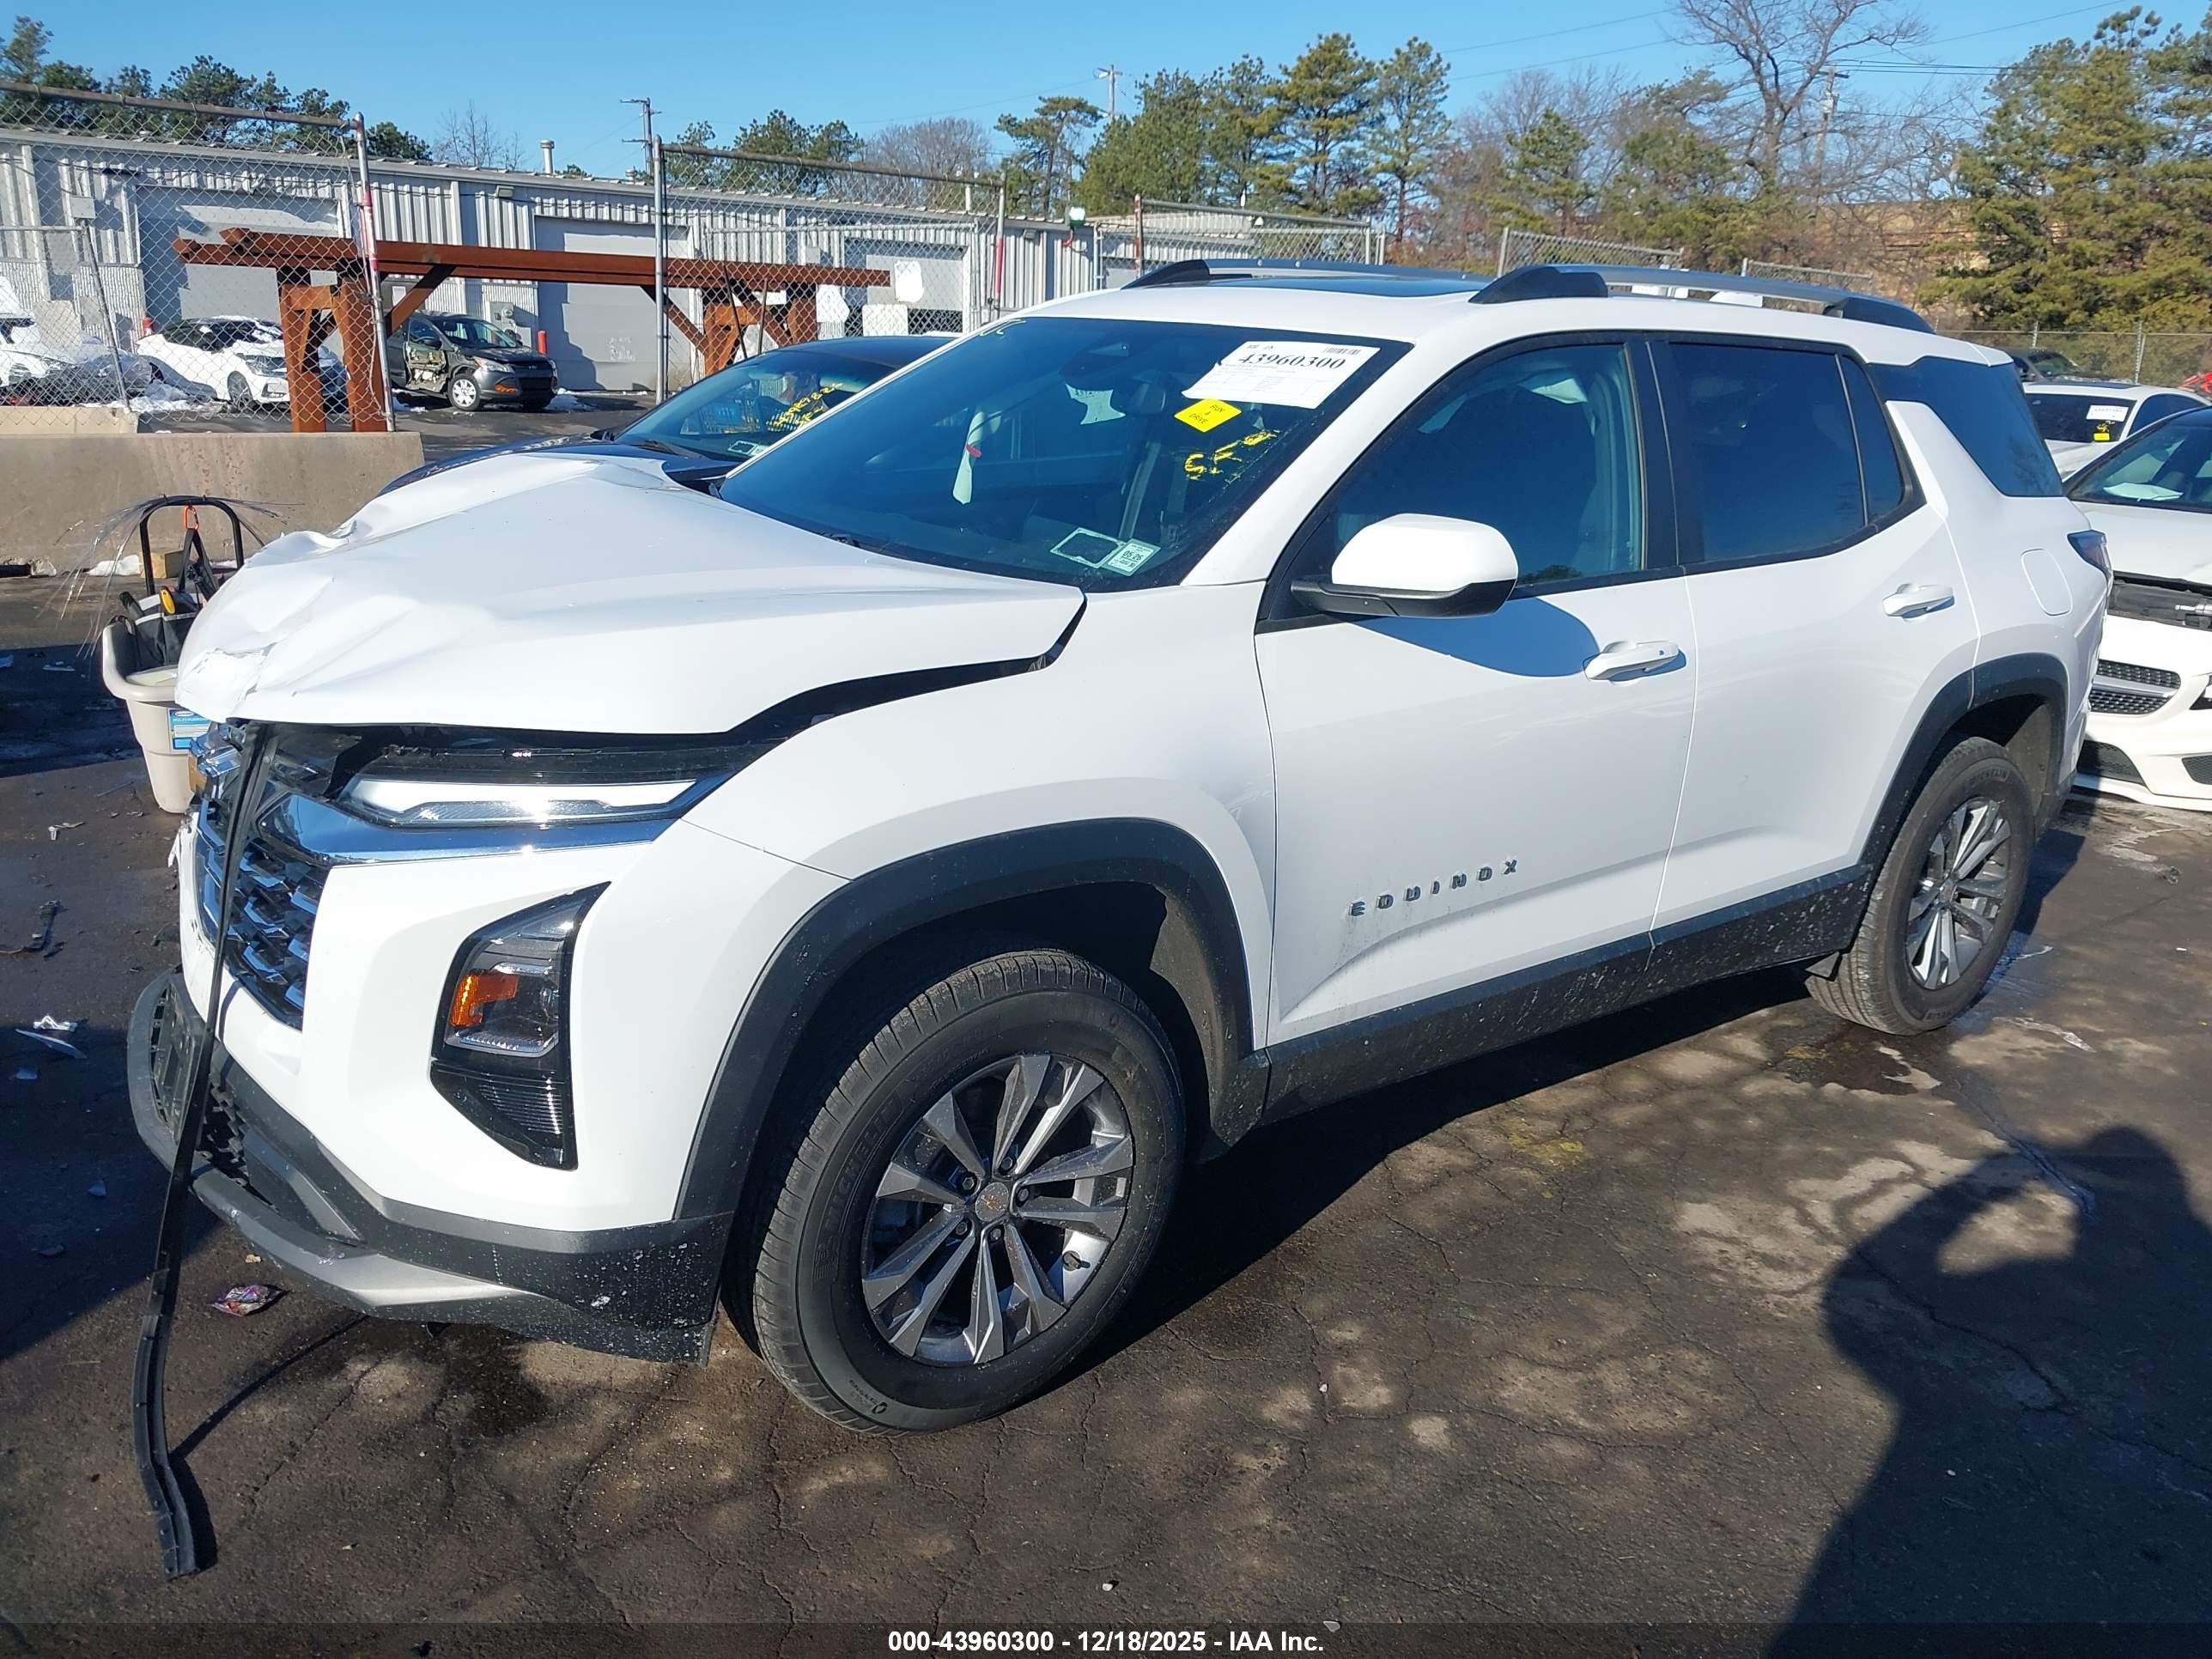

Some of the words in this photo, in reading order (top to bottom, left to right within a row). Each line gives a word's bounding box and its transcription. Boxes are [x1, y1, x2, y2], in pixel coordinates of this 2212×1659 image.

[1238, 353, 1346, 370] 43960300
[1209, 404, 1224, 413] RUN
[1188, 413, 1209, 423] DRIVE
[1348, 859, 1517, 917] EQUINOX
